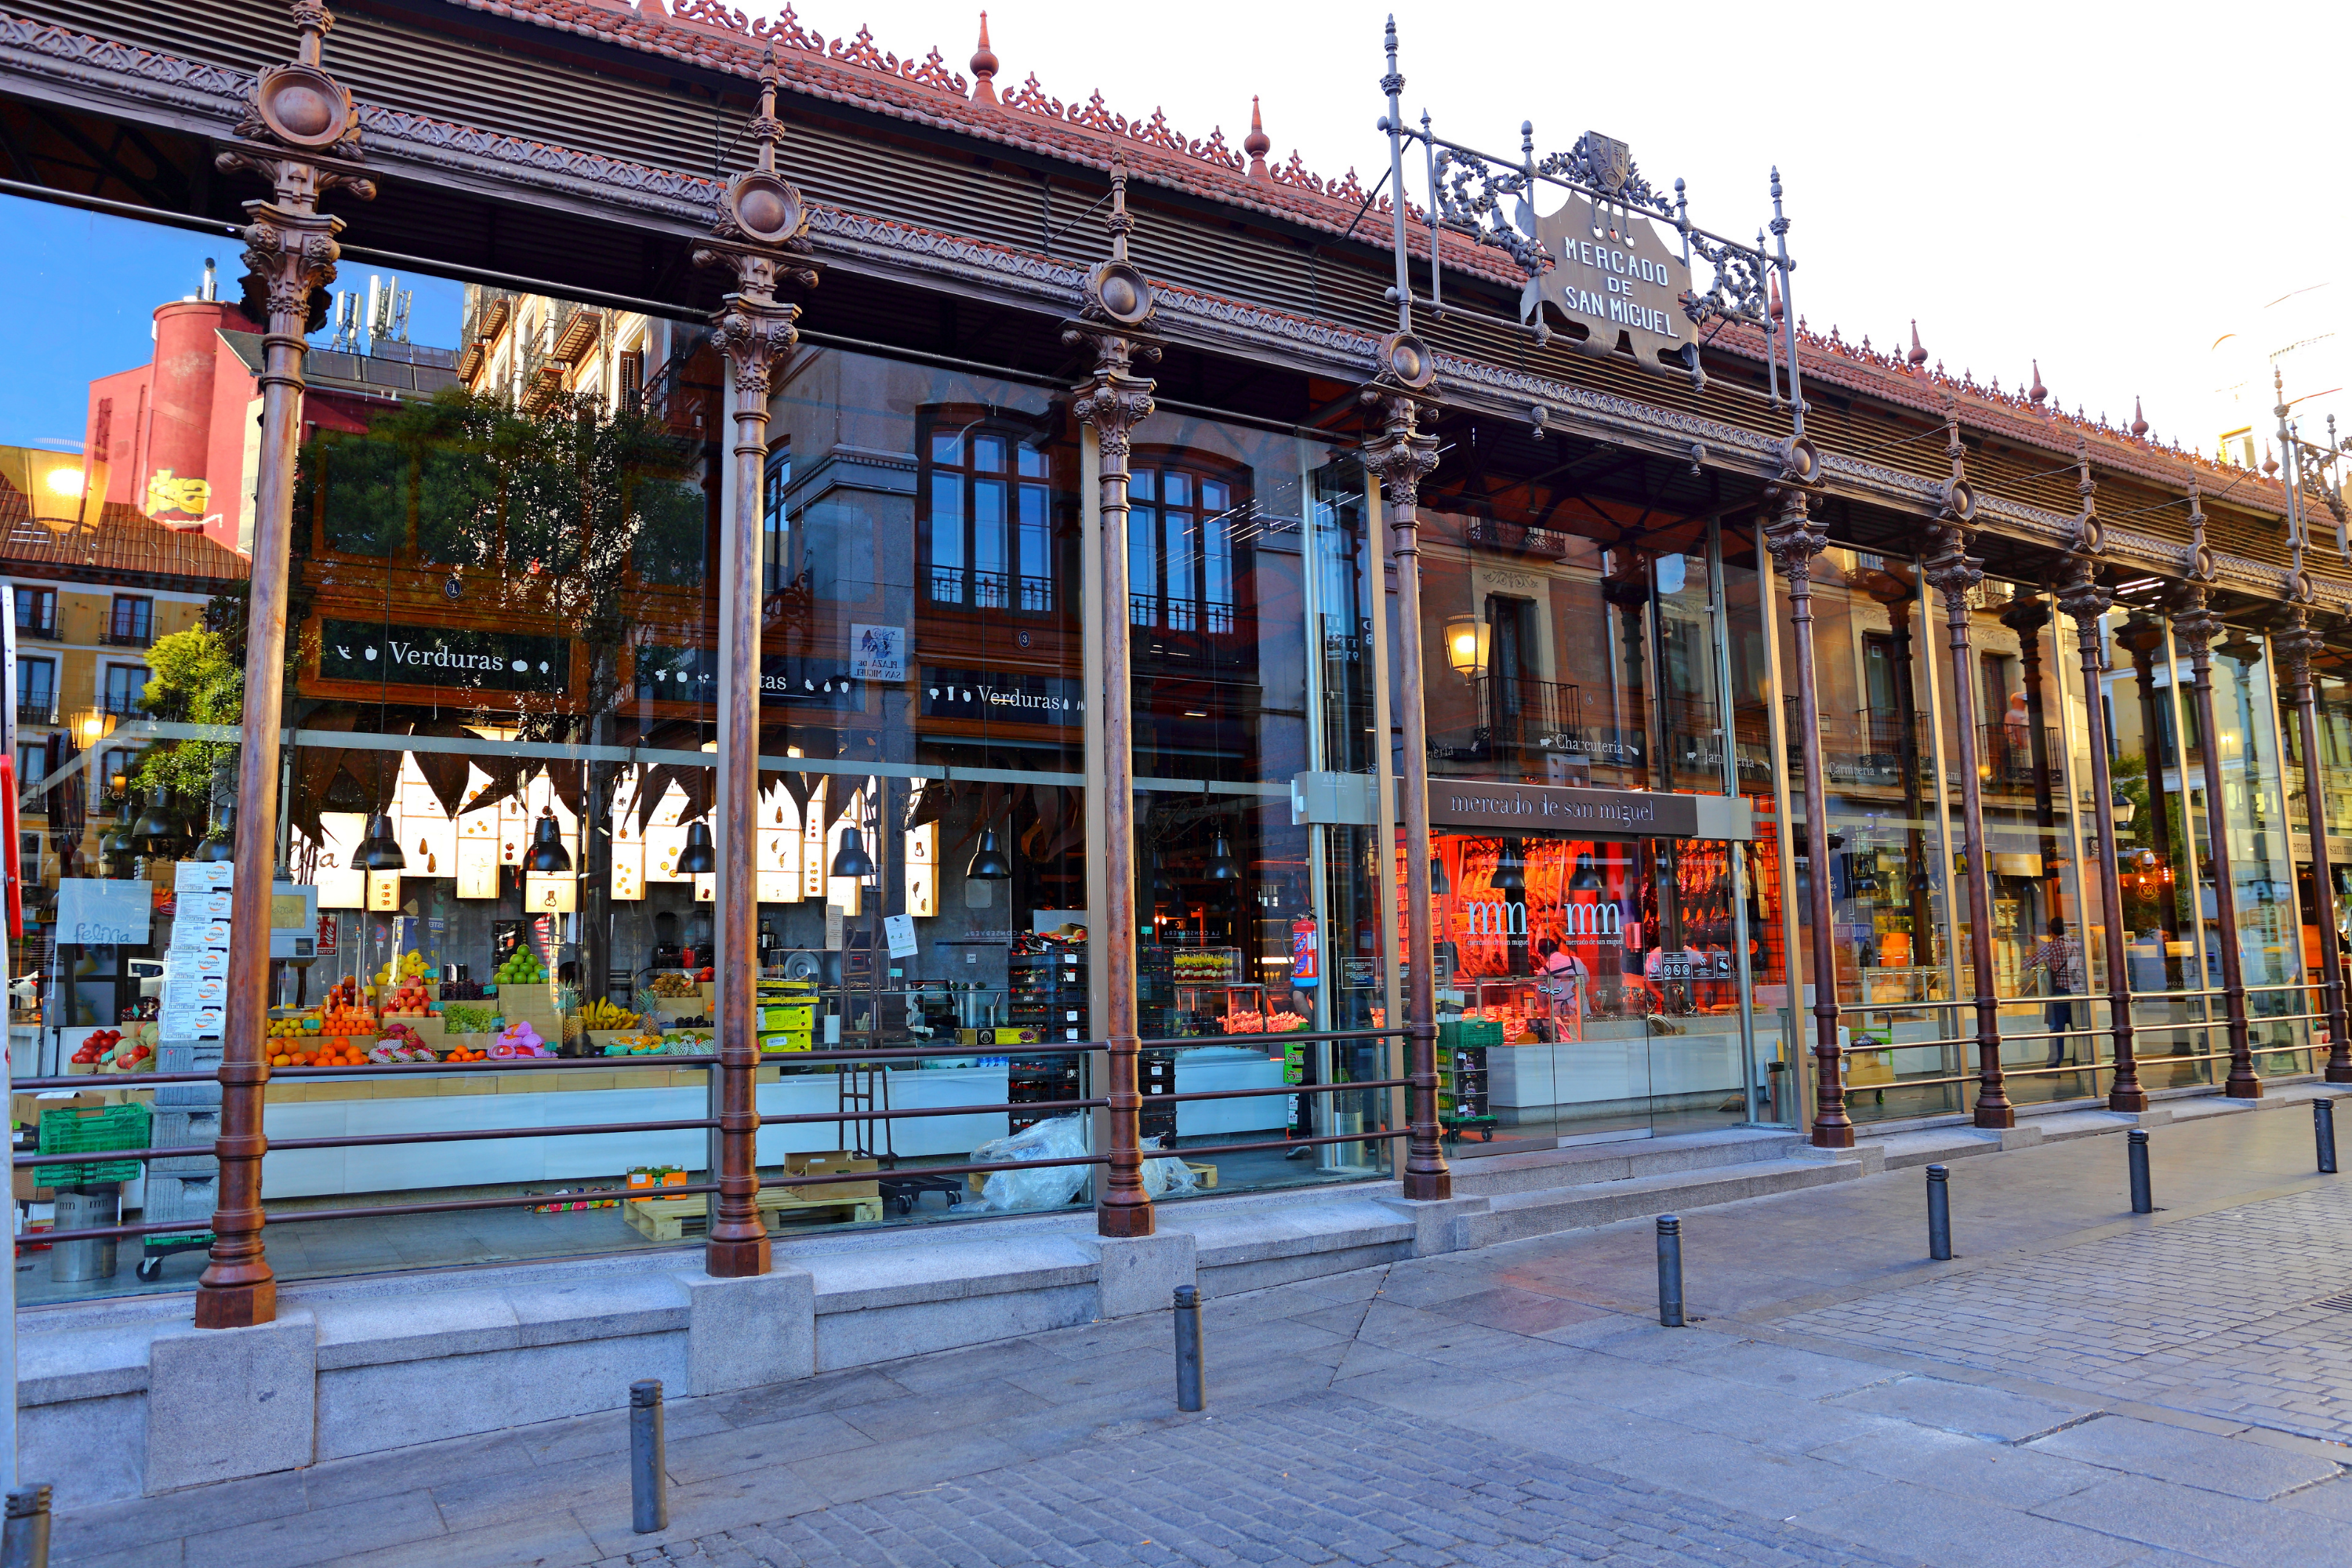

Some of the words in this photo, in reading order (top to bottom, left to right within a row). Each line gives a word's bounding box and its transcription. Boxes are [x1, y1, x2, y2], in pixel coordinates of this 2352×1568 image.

[1564, 236, 1668, 287] MERCADO
[1607, 276, 1633, 296] DE
[1565, 285, 1604, 318] SAN
[388, 641, 503, 671] Verduras
[976, 684, 1060, 710] Verduras
[1555, 732, 1624, 754] Charcutería
[1704, 747, 1755, 768] Jamería
[1450, 791, 1534, 815] mercado
[1538, 793, 1559, 816] de
[1564, 801, 1595, 818] san
[1599, 799, 1655, 828] miguel
[1512, 938, 1530, 948] miguel
[1606, 938, 1624, 947] miguel
